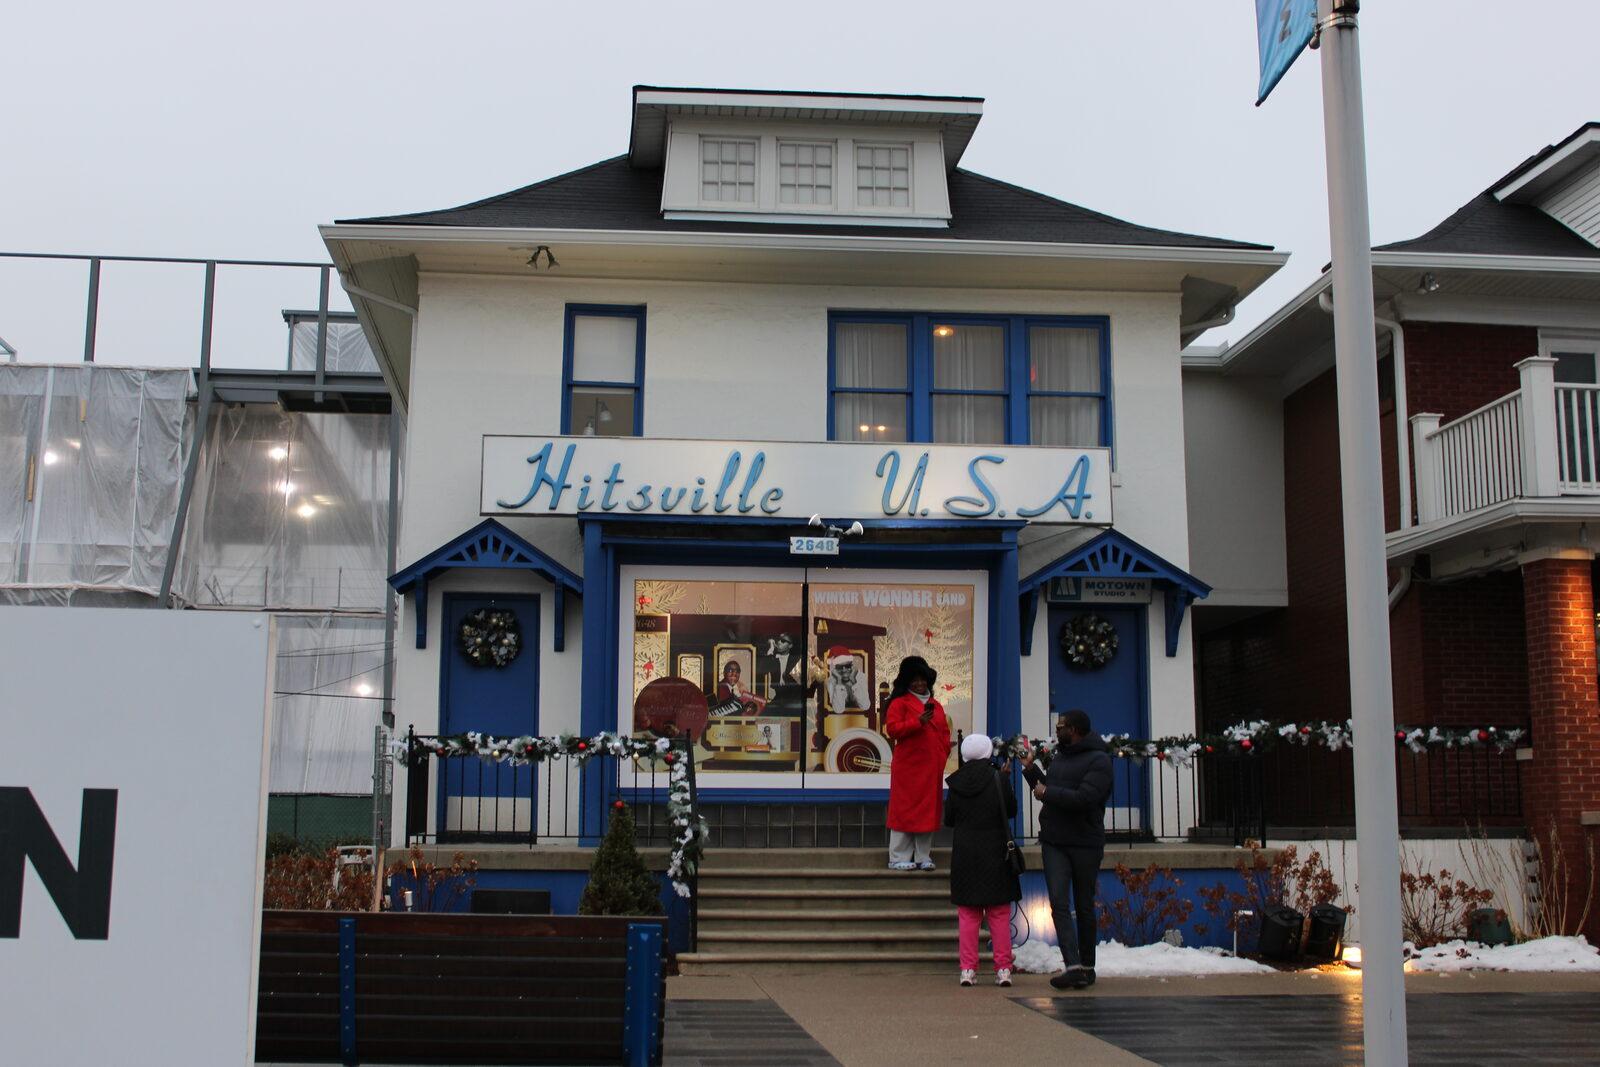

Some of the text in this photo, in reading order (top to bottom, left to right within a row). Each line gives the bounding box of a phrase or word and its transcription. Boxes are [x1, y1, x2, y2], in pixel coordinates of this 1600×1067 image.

[496, 442, 784, 514] Hitsville
[795, 539, 834, 551] 2648
[1086, 581, 1145, 590] MOTOWN
[814, 590, 967, 608] WINTER WONDER LAND
[0, 786, 118, 940] N
